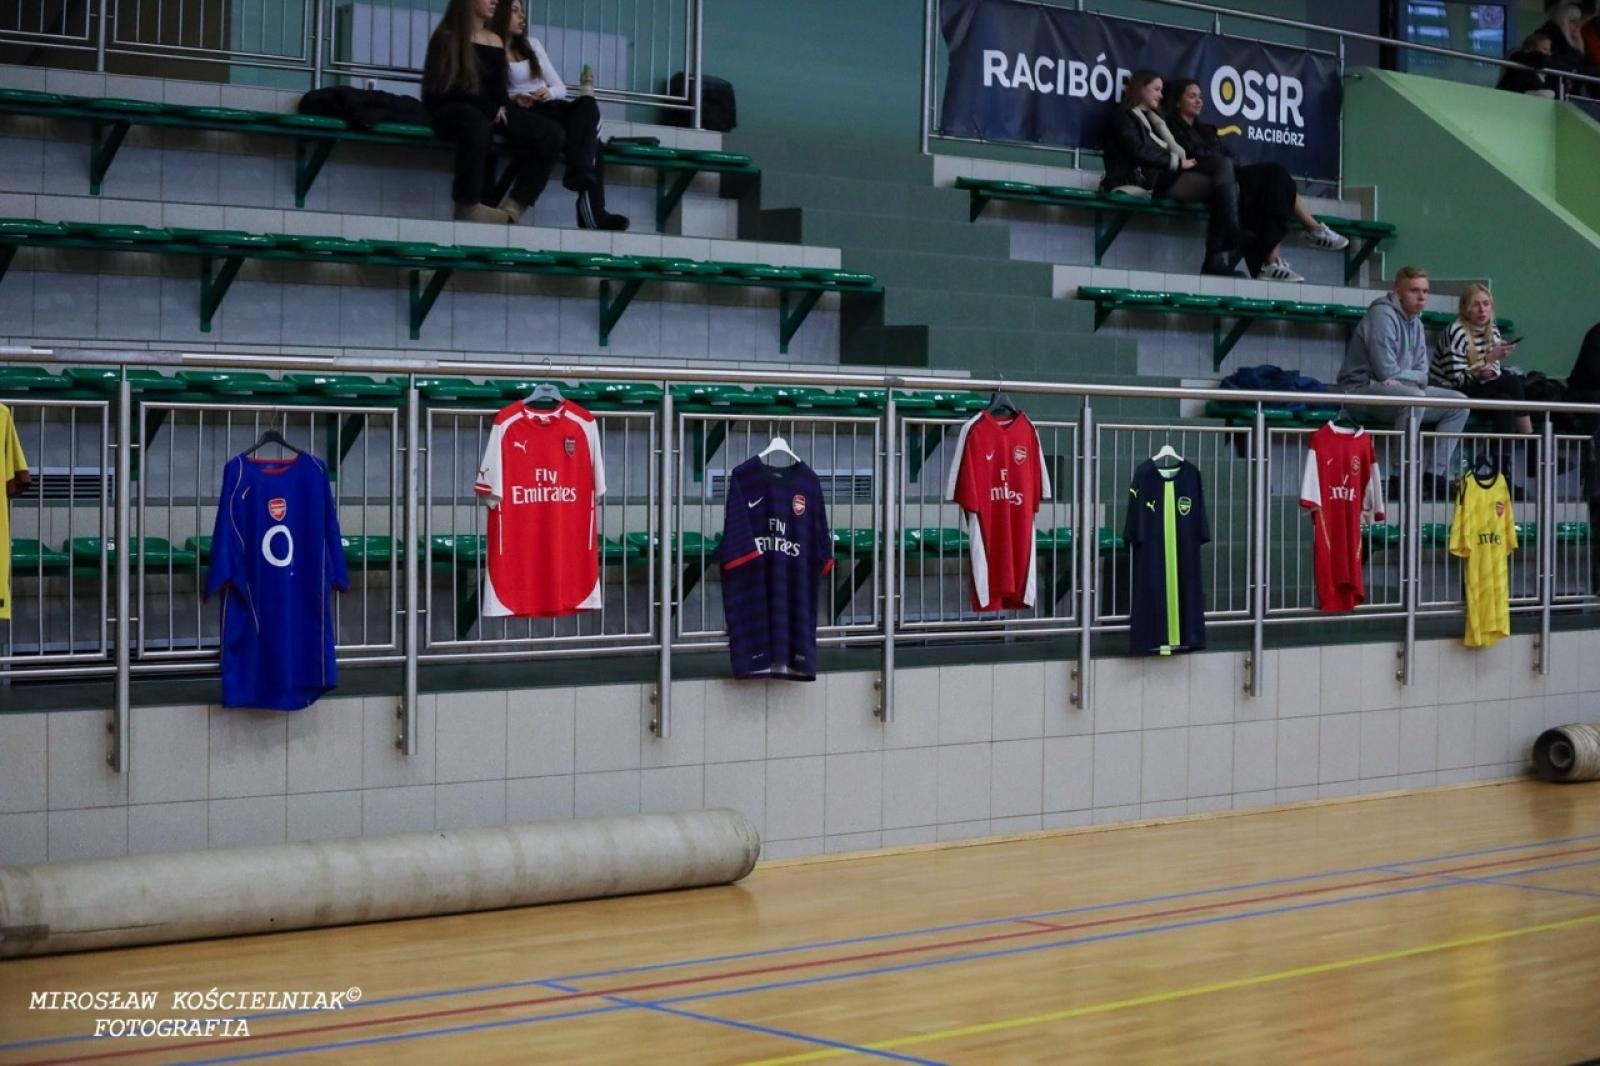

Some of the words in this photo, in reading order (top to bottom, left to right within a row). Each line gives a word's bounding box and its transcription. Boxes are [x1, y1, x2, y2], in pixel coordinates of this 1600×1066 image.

[983, 49, 1133, 104] RACIBÓR
[1210, 65, 1305, 127] OSiR
[1247, 125, 1305, 147] RACIBÓRZ
[535, 468, 558, 484] Fly
[768, 518, 786, 535] Fly
[754, 533, 801, 557] Emiraes
